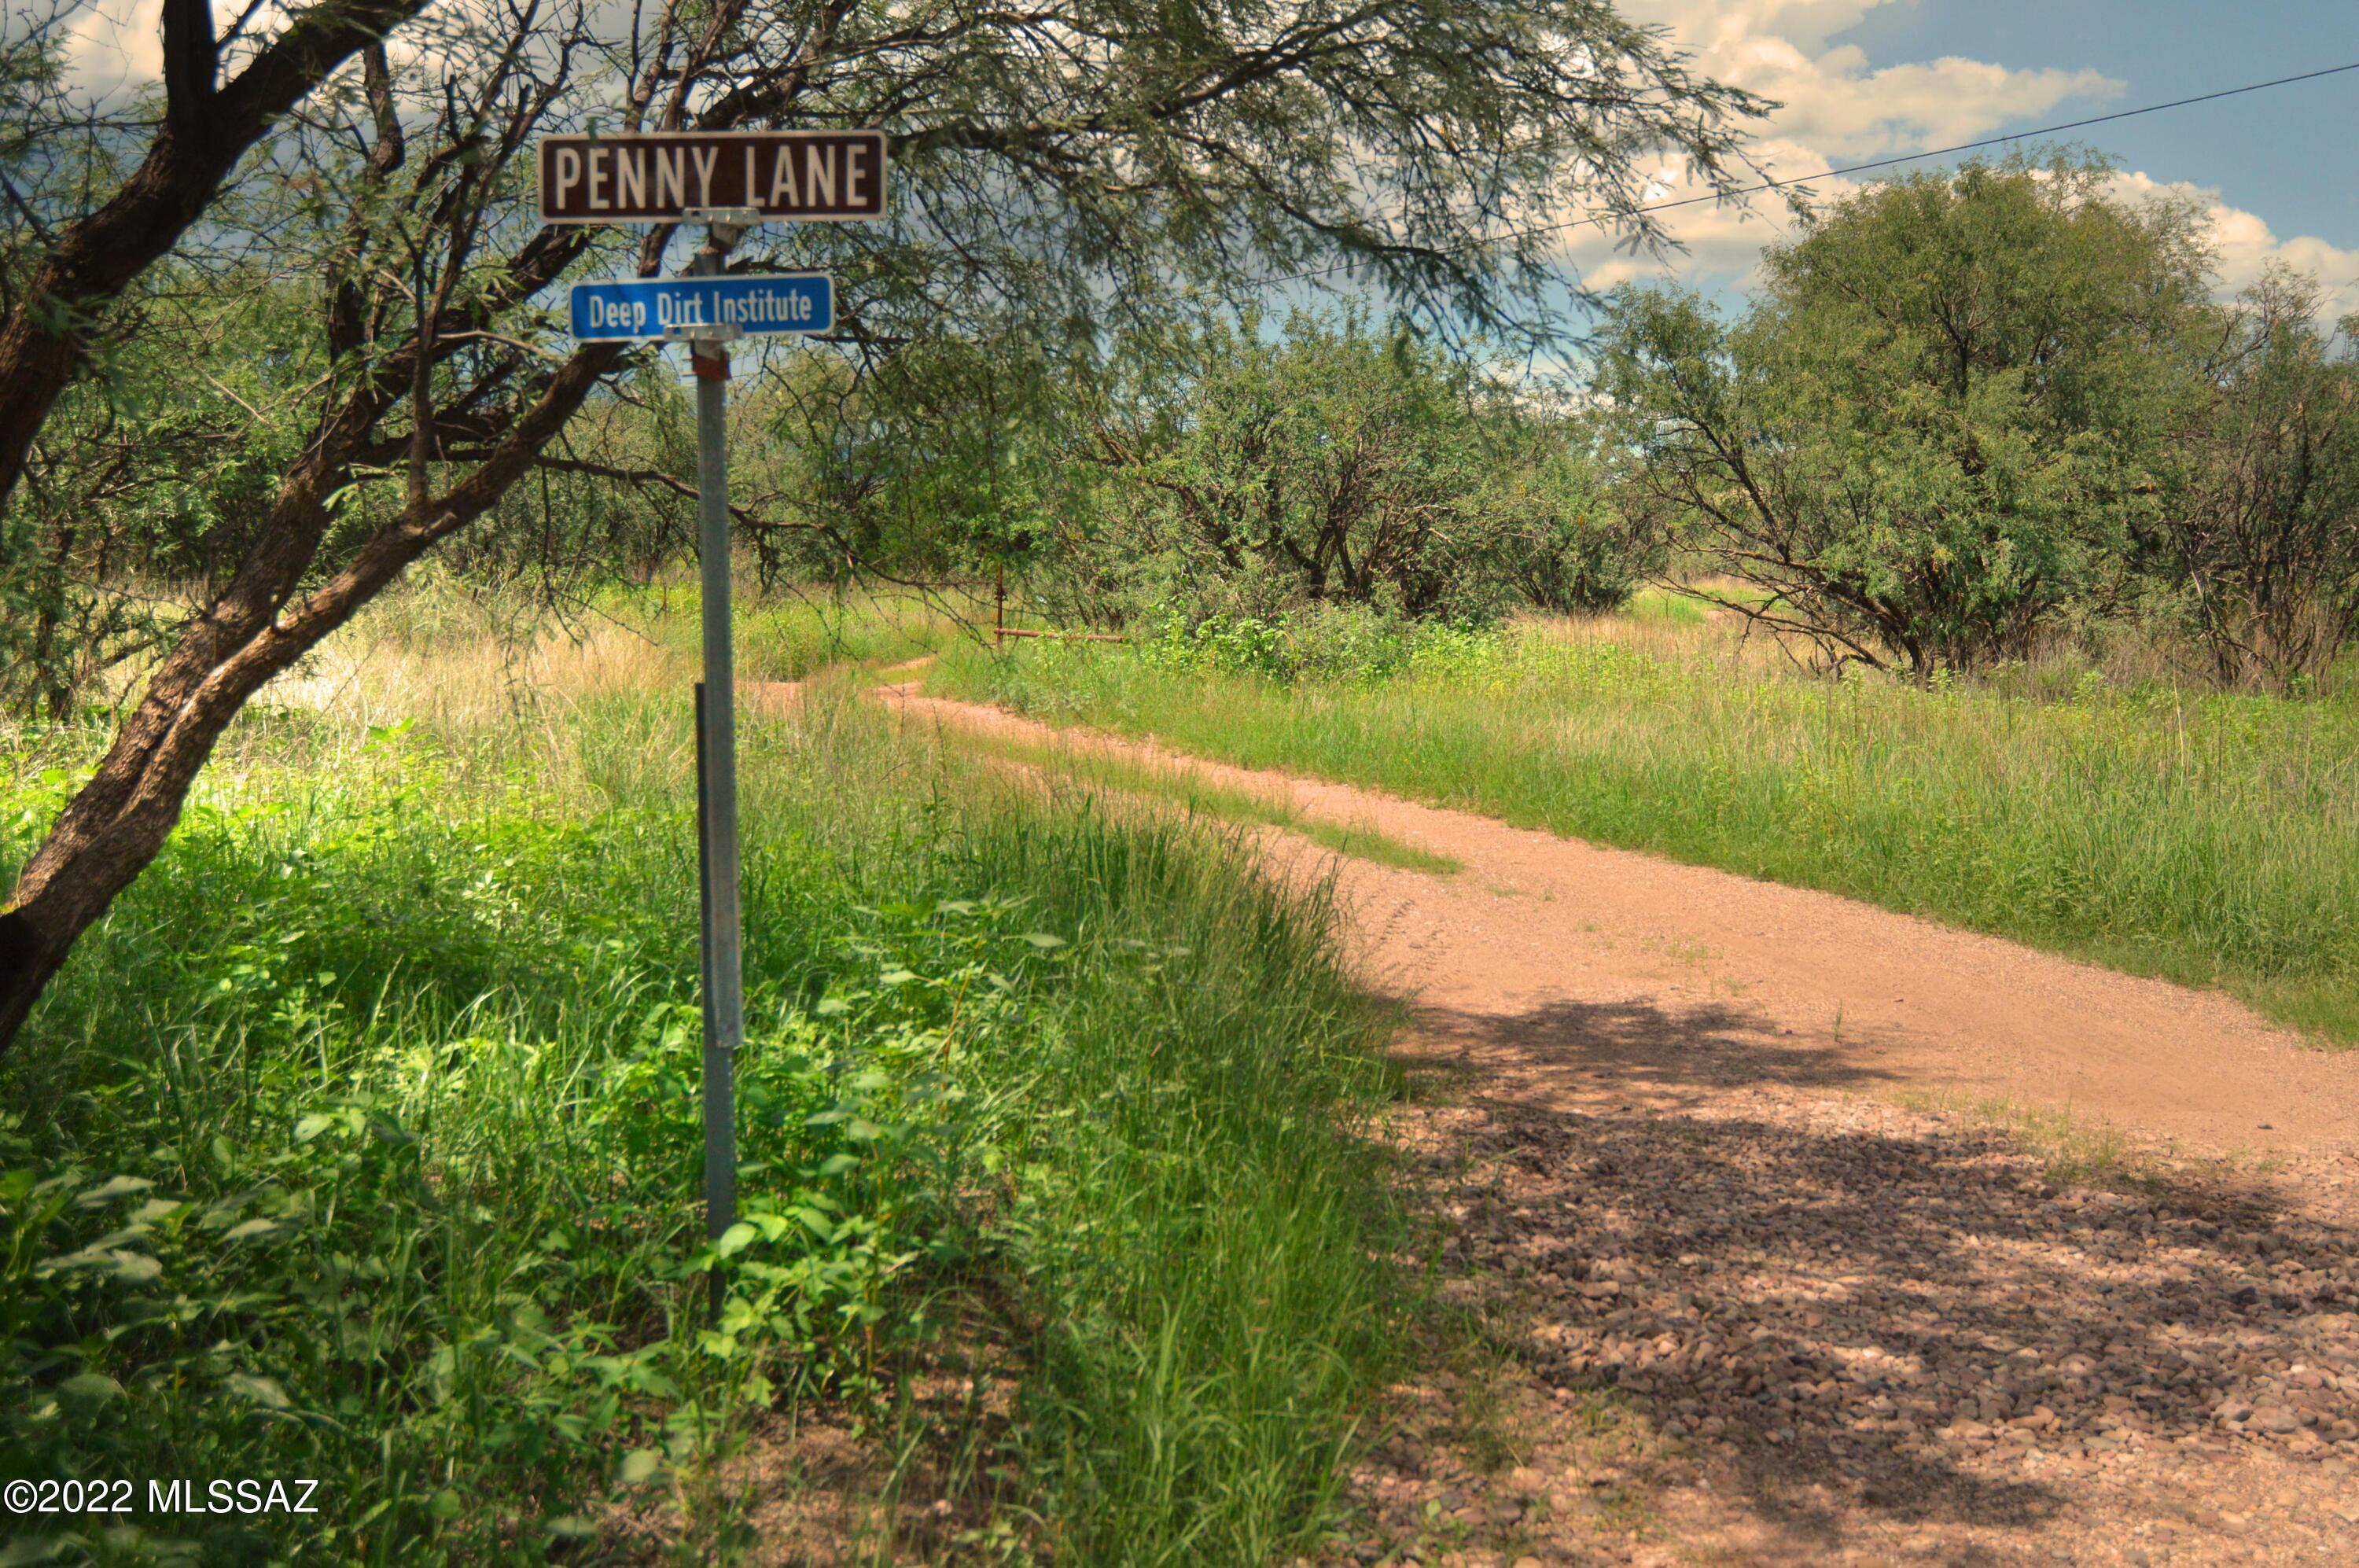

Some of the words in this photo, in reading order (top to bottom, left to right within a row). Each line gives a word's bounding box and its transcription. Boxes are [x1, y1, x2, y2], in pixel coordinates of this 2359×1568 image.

[554, 146, 719, 210] PENNY
[745, 144, 868, 207] LANE
[589, 296, 646, 333] Deep
[657, 291, 703, 325] Dirt
[713, 288, 812, 323] Institute
